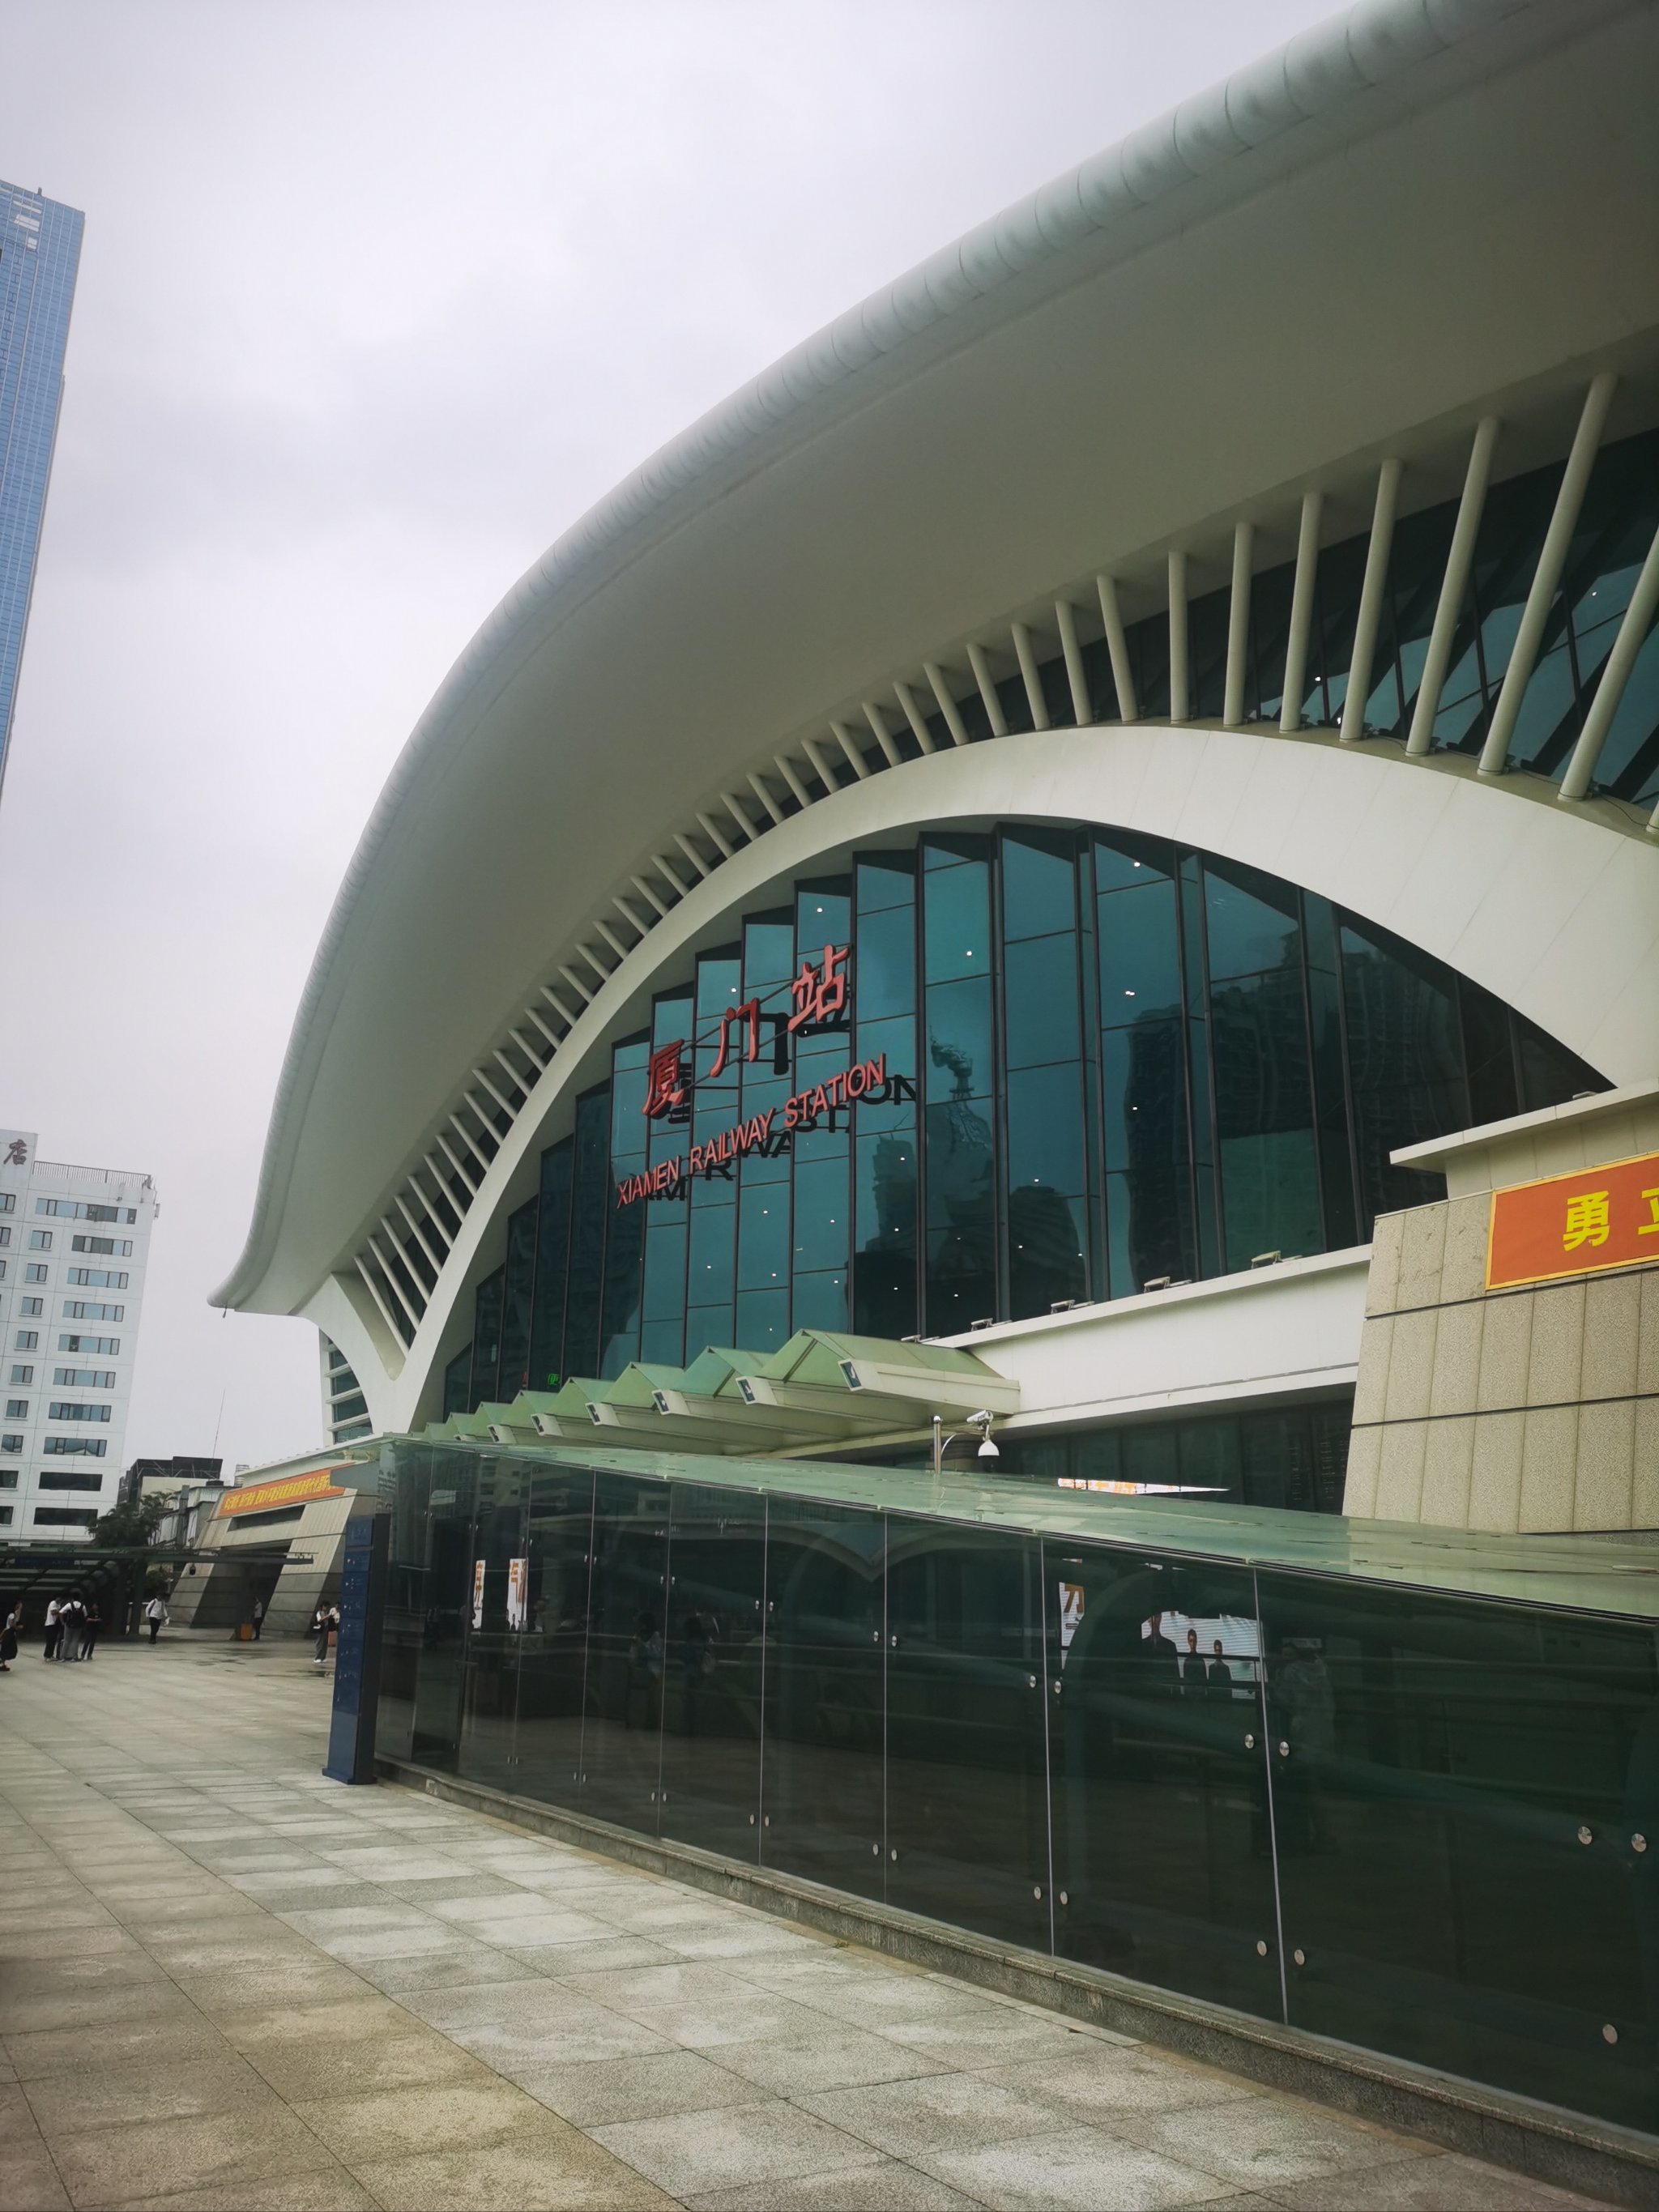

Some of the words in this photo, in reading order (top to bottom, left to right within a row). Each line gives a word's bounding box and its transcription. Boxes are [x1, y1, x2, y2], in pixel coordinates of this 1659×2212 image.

[642, 944, 850, 1115] 厦门站
[3, 1139, 28, 1165] 店
[617, 1156, 681, 1209] XIAMEN
[690, 1108, 775, 1174] RAILWAY
[784, 1053, 886, 1127] STATION
